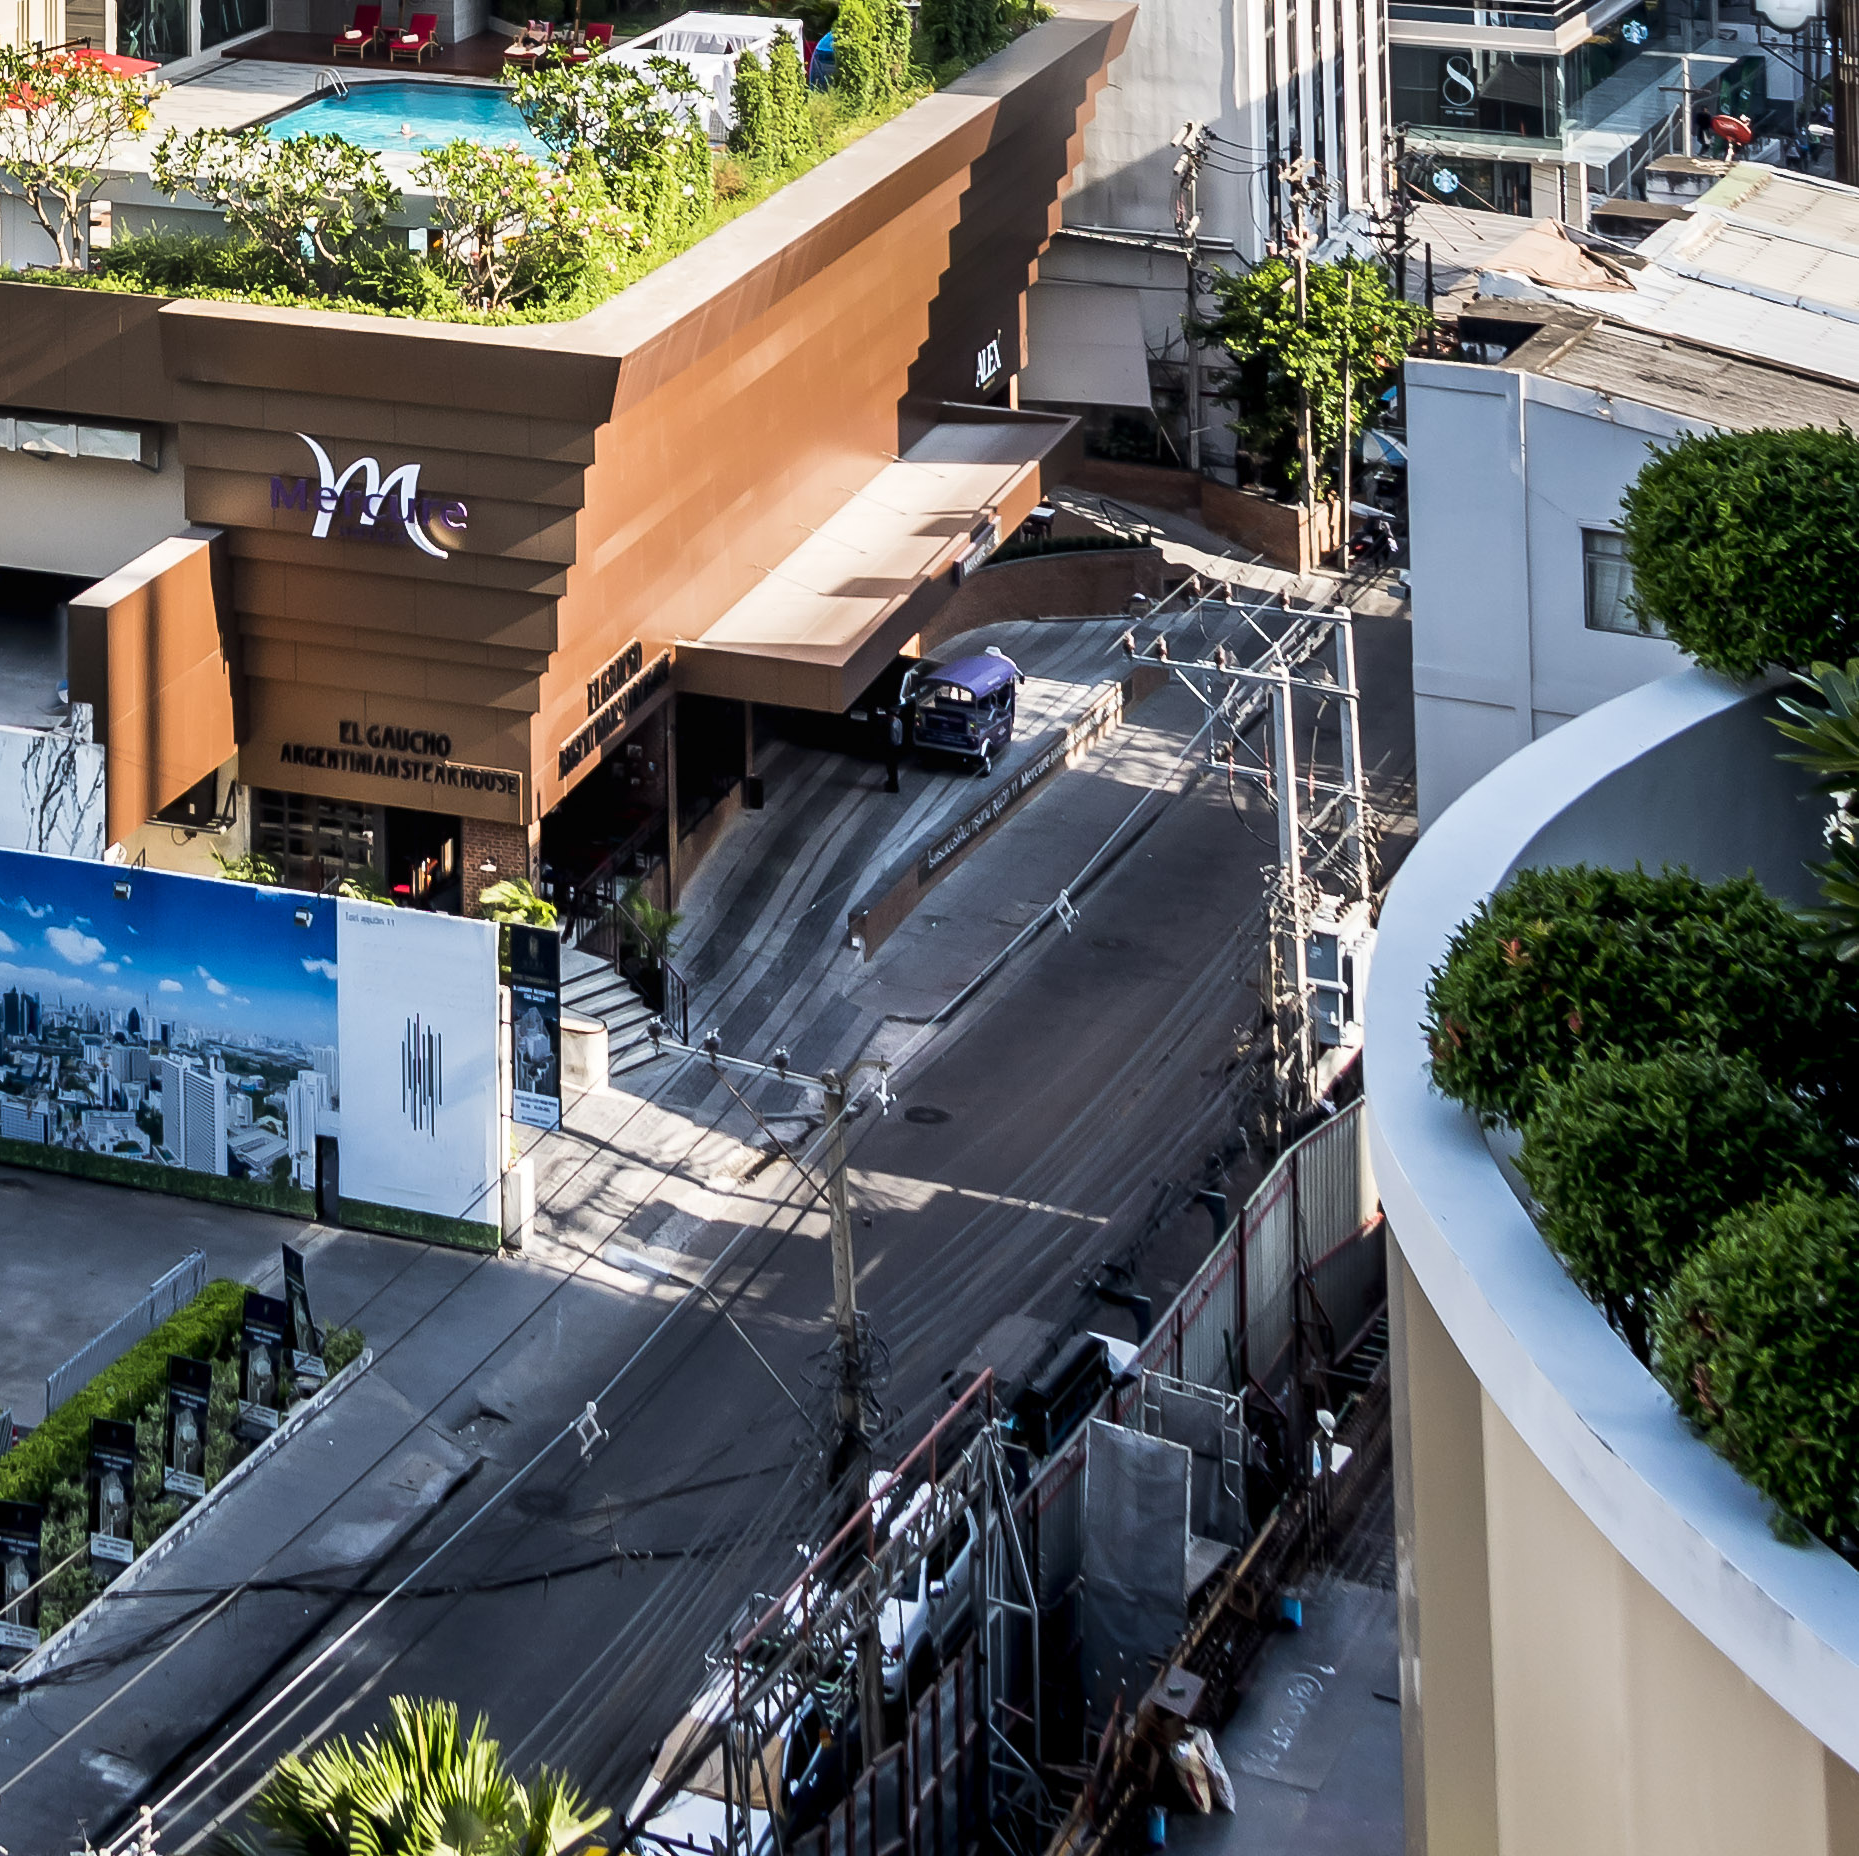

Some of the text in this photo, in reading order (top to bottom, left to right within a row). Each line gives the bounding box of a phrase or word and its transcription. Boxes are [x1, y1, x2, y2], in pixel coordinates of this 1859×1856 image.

[270, 476, 468, 530] Mercure
[339, 720, 452, 758] EL GAUCHO
[280, 742, 518, 795] ARGENTINIAN STEAKHOUSE
